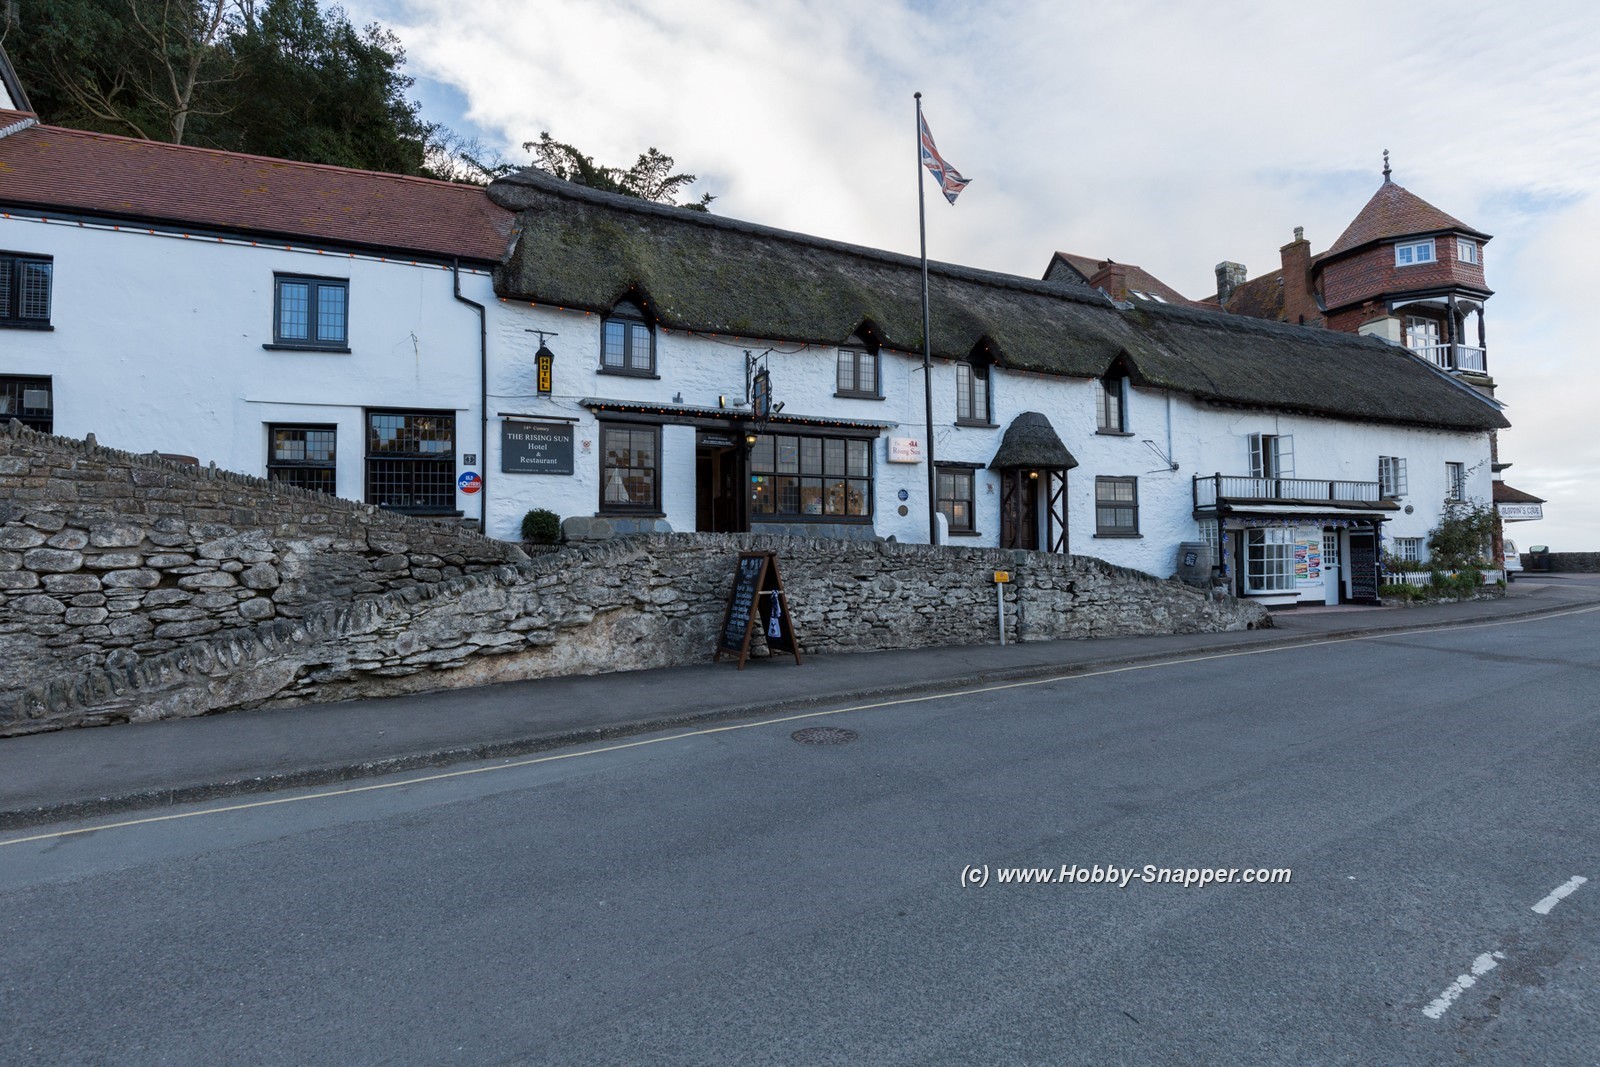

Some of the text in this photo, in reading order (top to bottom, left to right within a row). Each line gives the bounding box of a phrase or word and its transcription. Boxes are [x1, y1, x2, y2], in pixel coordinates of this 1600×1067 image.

[541, 358, 549, 390] HOTEL
[507, 433, 570, 443] THE RISING SUN
[910, 447, 921, 456] Sun
[520, 456, 558, 465] Restaurant
